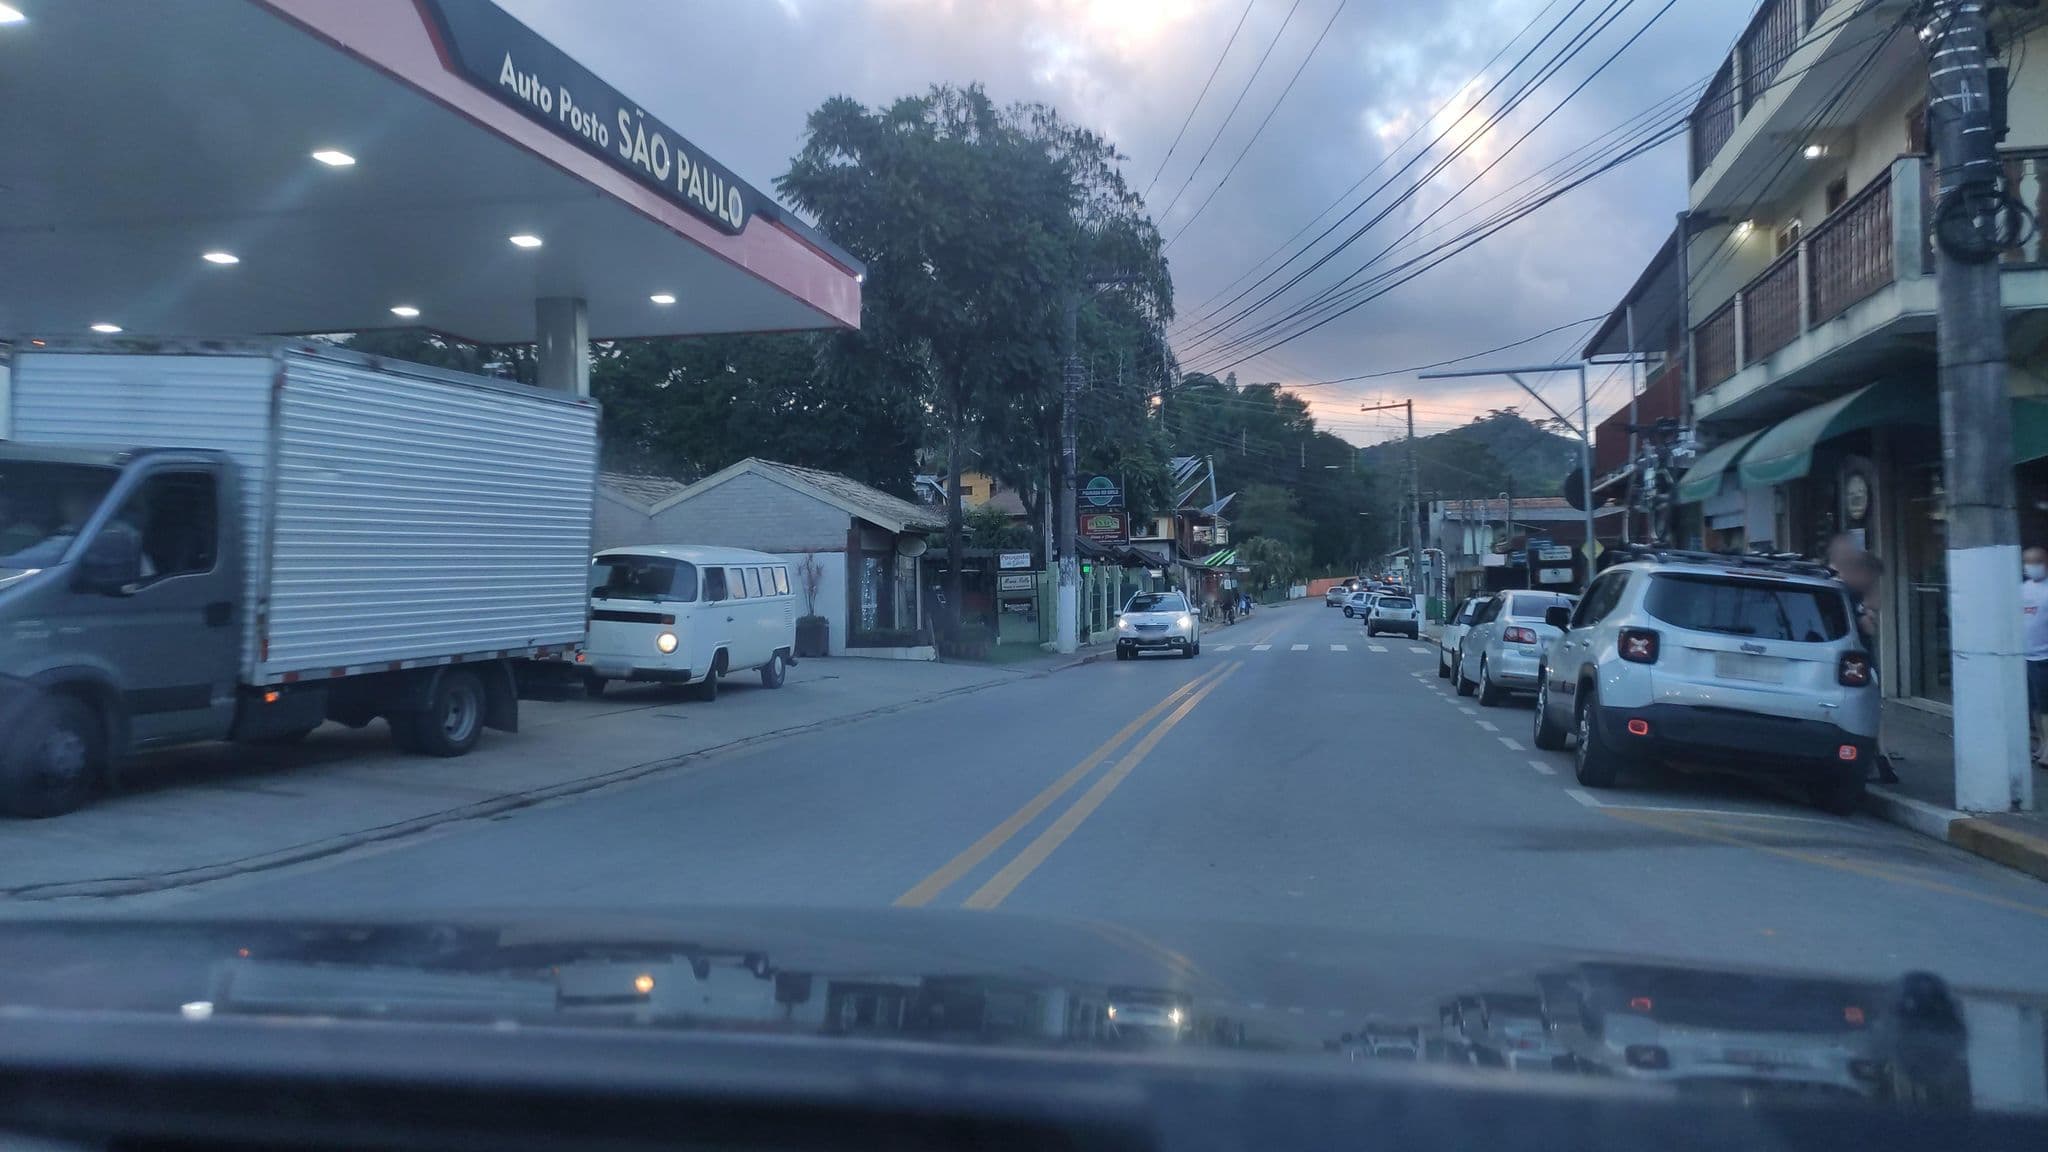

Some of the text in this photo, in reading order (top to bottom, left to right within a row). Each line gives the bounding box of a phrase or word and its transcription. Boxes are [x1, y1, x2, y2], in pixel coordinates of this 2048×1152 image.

[499, 52, 743, 229] Auto Posto SÃO PAULO
